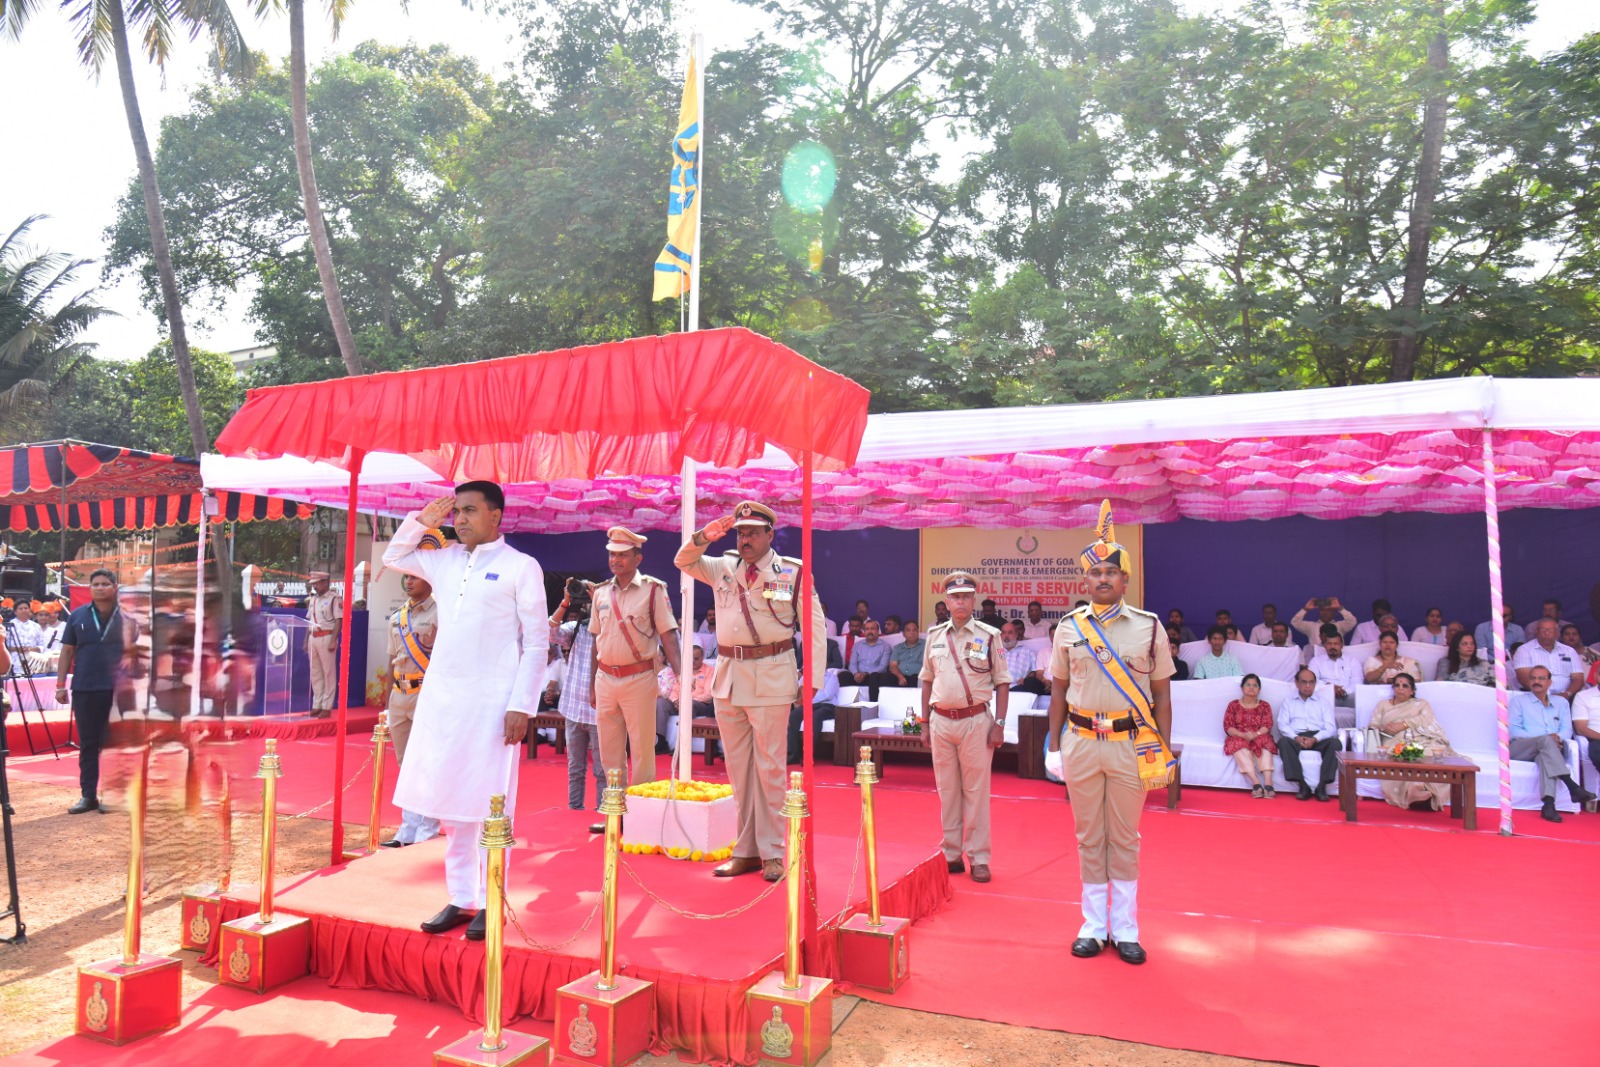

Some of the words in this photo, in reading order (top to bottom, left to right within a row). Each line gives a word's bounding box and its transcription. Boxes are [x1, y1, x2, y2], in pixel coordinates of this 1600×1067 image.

[988, 567, 999, 575] OF
[1001, 567, 1020, 575] FIRE
[1022, 567, 1029, 575] &
[1002, 582, 1032, 594] FIRE
[1036, 582, 1090, 594] SERVIC
[1010, 609, 1025, 619] Dr.
